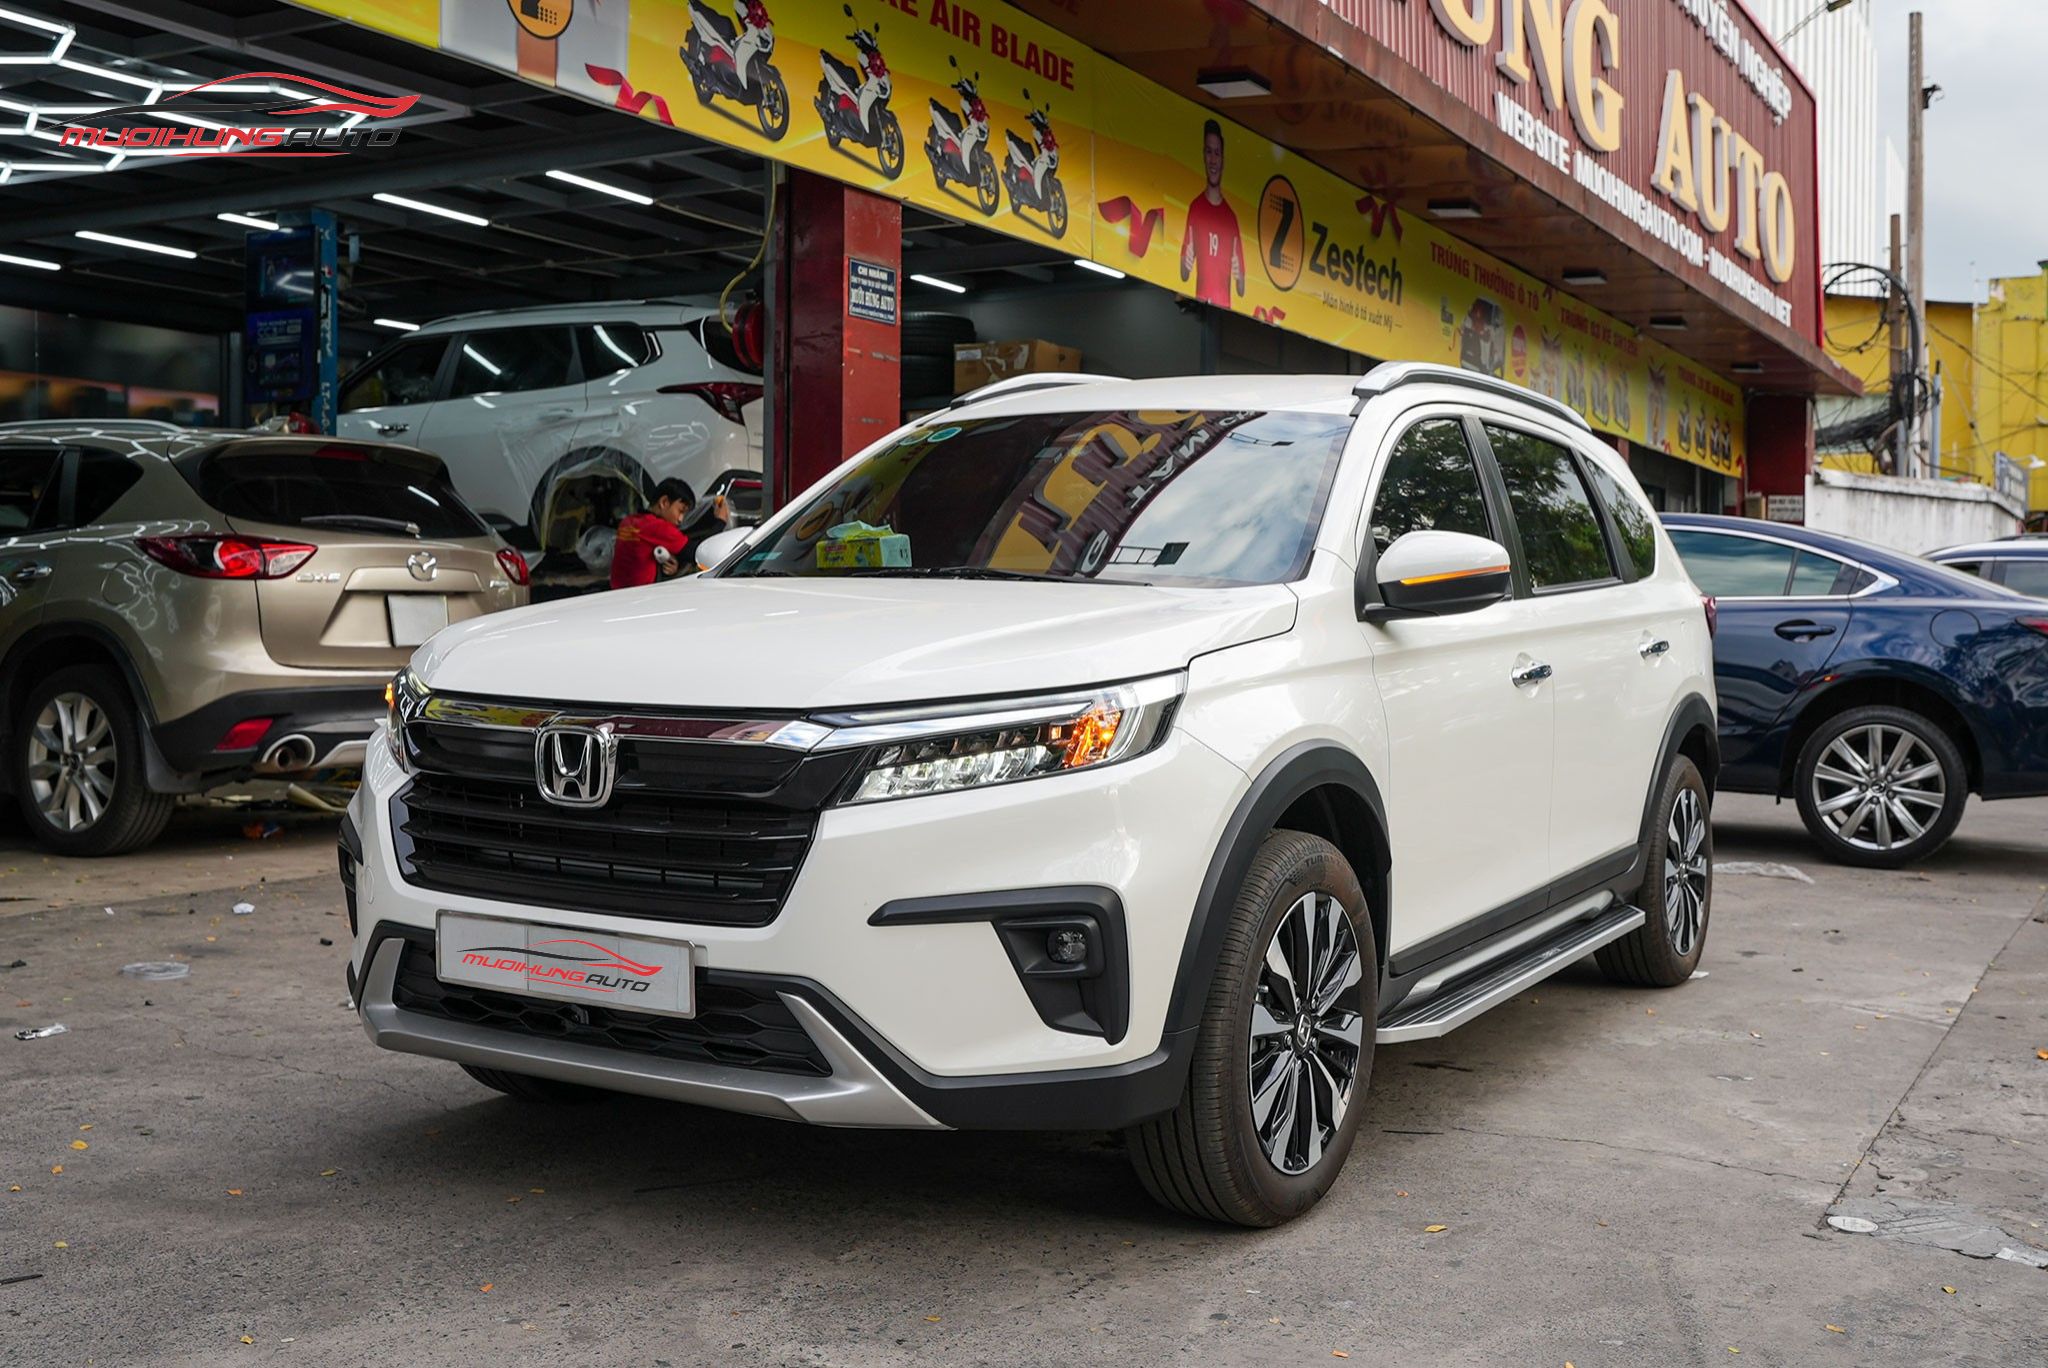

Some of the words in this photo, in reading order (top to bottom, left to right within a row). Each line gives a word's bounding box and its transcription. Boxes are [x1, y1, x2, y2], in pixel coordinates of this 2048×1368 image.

[929, 0, 980, 48] AIR
[991, 23, 1075, 91] BLADE
[1494, 91, 1570, 175] WEBSITE
[1650, 68, 1797, 284] AUTO
[1208, 231, 1219, 257] 19
[1308, 221, 1405, 306] Zestech
[1430, 241, 1471, 279] TRÚNG
